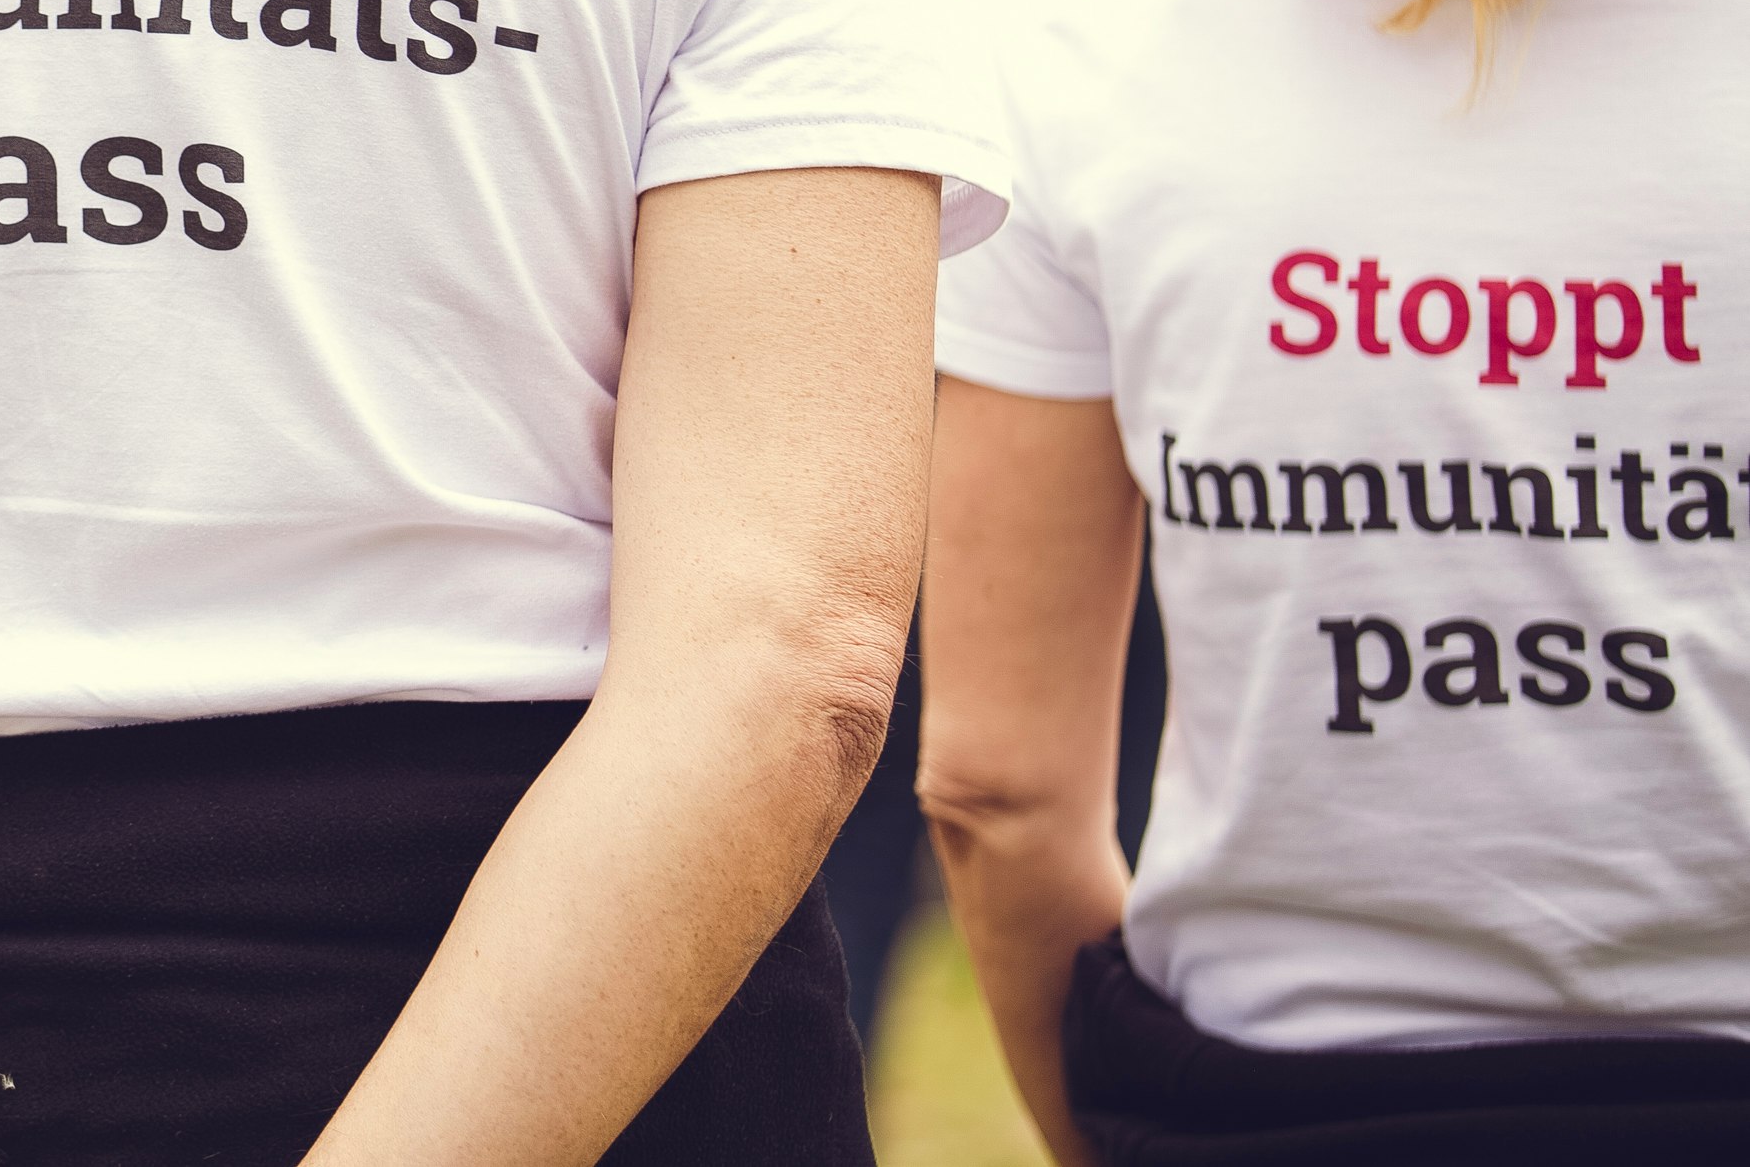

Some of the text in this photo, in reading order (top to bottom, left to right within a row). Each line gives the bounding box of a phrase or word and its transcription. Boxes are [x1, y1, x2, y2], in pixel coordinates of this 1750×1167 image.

[1268, 251, 1701, 390] Stoppt
[1161, 431, 1750, 546] Immunitä
[1317, 614, 1677, 739] pass
